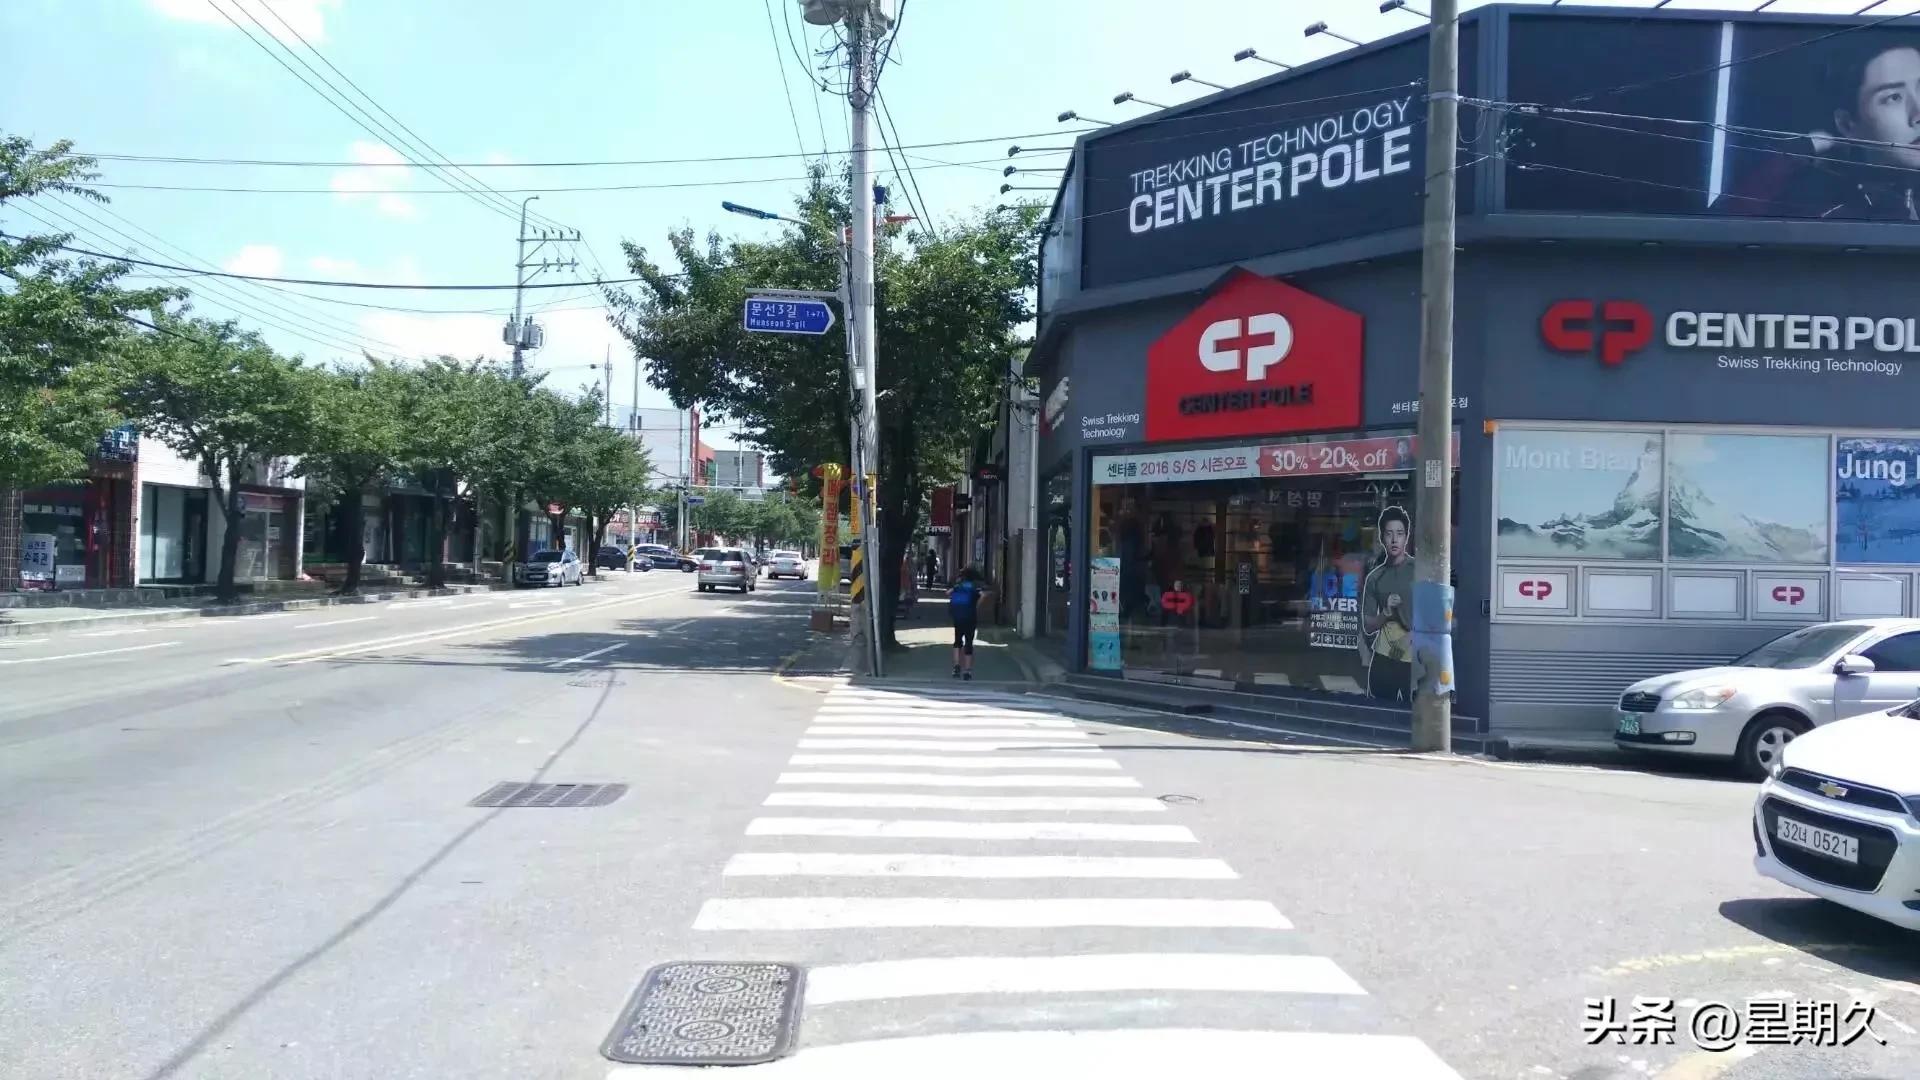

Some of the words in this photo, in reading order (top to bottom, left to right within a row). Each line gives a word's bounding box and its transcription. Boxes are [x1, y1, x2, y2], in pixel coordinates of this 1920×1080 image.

[1131, 148, 1232, 193] TREKKING
[1239, 96, 1412, 165] TECHNOLOGY
[1129, 161, 1282, 234] CENTER
[1291, 126, 1411, 198] POLE
[751, 302, 797, 319] 문선3길
[750, 318, 785, 327] Munseon
[786, 320, 806, 329] 3-gil
[1665, 311, 1840, 350] CENTER
[1717, 355, 1759, 369] Swiss
[1763, 356, 1820, 374] Trekking
[1824, 358, 1902, 376] Technology
[1178, 390, 1256, 416] CENTER
[1260, 383, 1314, 408] POLE
[1081, 416, 1105, 427] Swiss
[1106, 413, 1140, 424] Trekking
[1082, 427, 1126, 439] Technology
[1107, 462, 1138, 477] 센터폴
[1140, 460, 1170, 476] 2016
[1172, 458, 1197, 475] S/S
[1200, 456, 1248, 473] 시즌오프
[1363, 449, 1388, 466] off
[1505, 443, 1571, 471] Mont
[1838, 453, 1906, 486] Jung
[1311, 597, 1358, 612] FLYER
[1783, 820, 1807, 843] 32너
[1813, 831, 1848, 856] 0521
